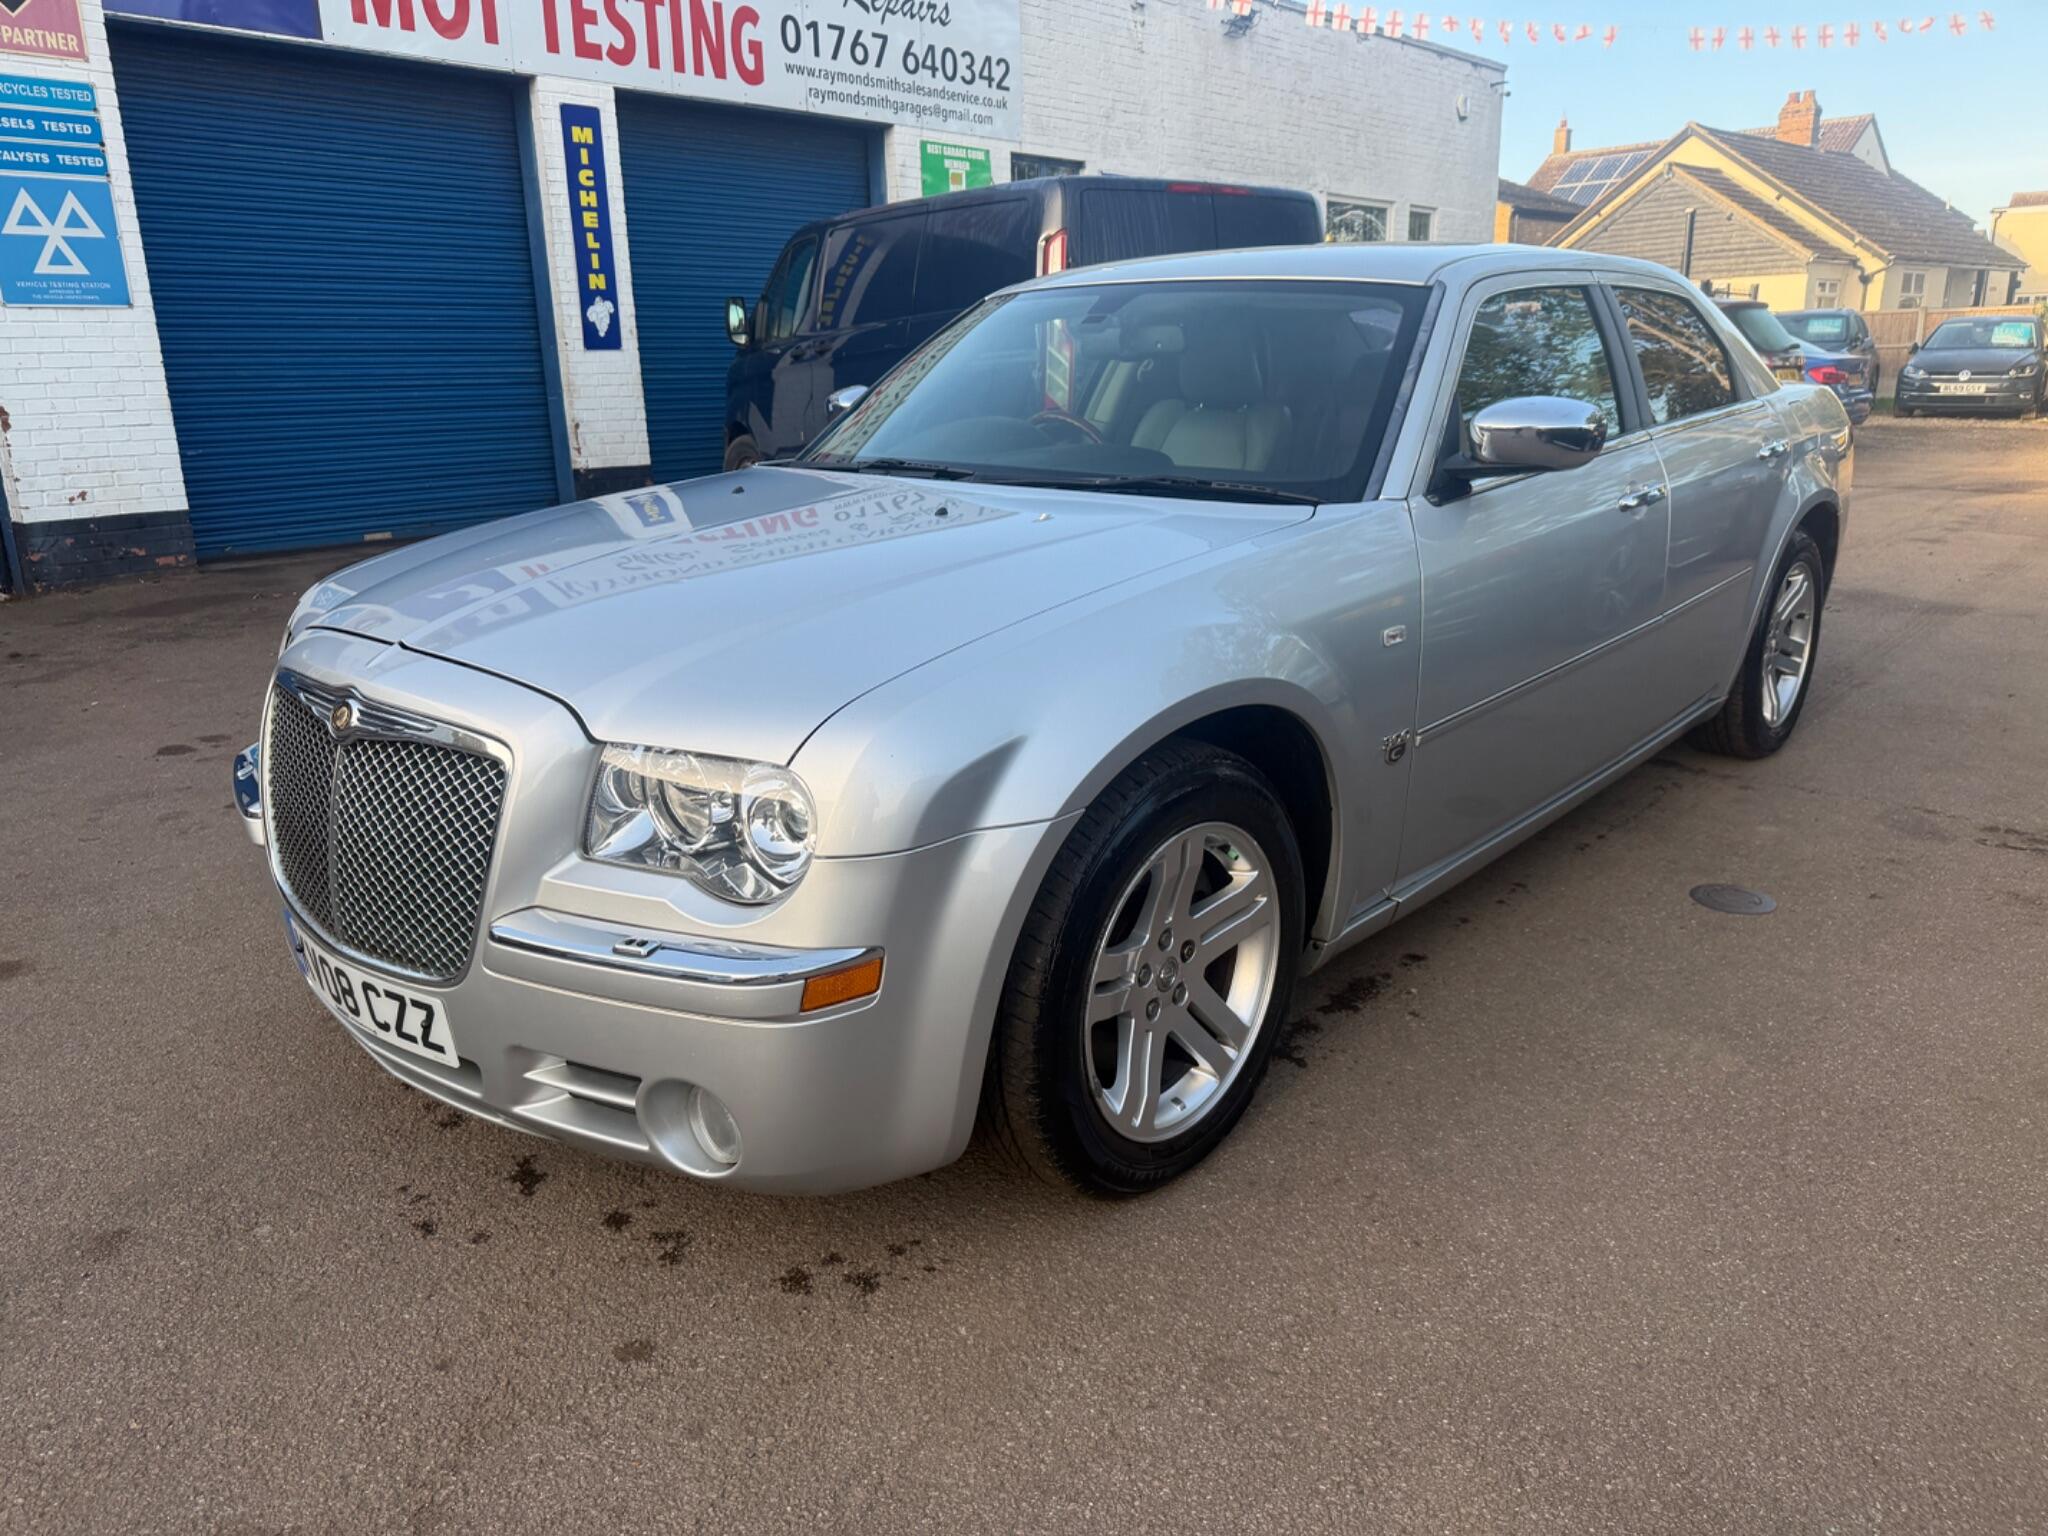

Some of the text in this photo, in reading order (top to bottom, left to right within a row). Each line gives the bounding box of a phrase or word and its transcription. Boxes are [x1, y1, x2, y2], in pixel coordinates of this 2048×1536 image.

[0, 24, 79, 52] PARTNER
[538, 0, 765, 86] TESTING
[780, 14, 1011, 92] 01767 640342
[51, 87, 91, 101] TESTED
[784, 61, 1008, 110] www.raymondsmithsalesandservice.co.uk
[808, 87, 993, 125] raymondsmithgarages@gmail.com
[0, 117, 92, 134] SELS TESTED
[56, 154, 104, 167] TESTED
[571, 126, 607, 290] MICHELIN
[361, 980, 447, 1055] CZZ
